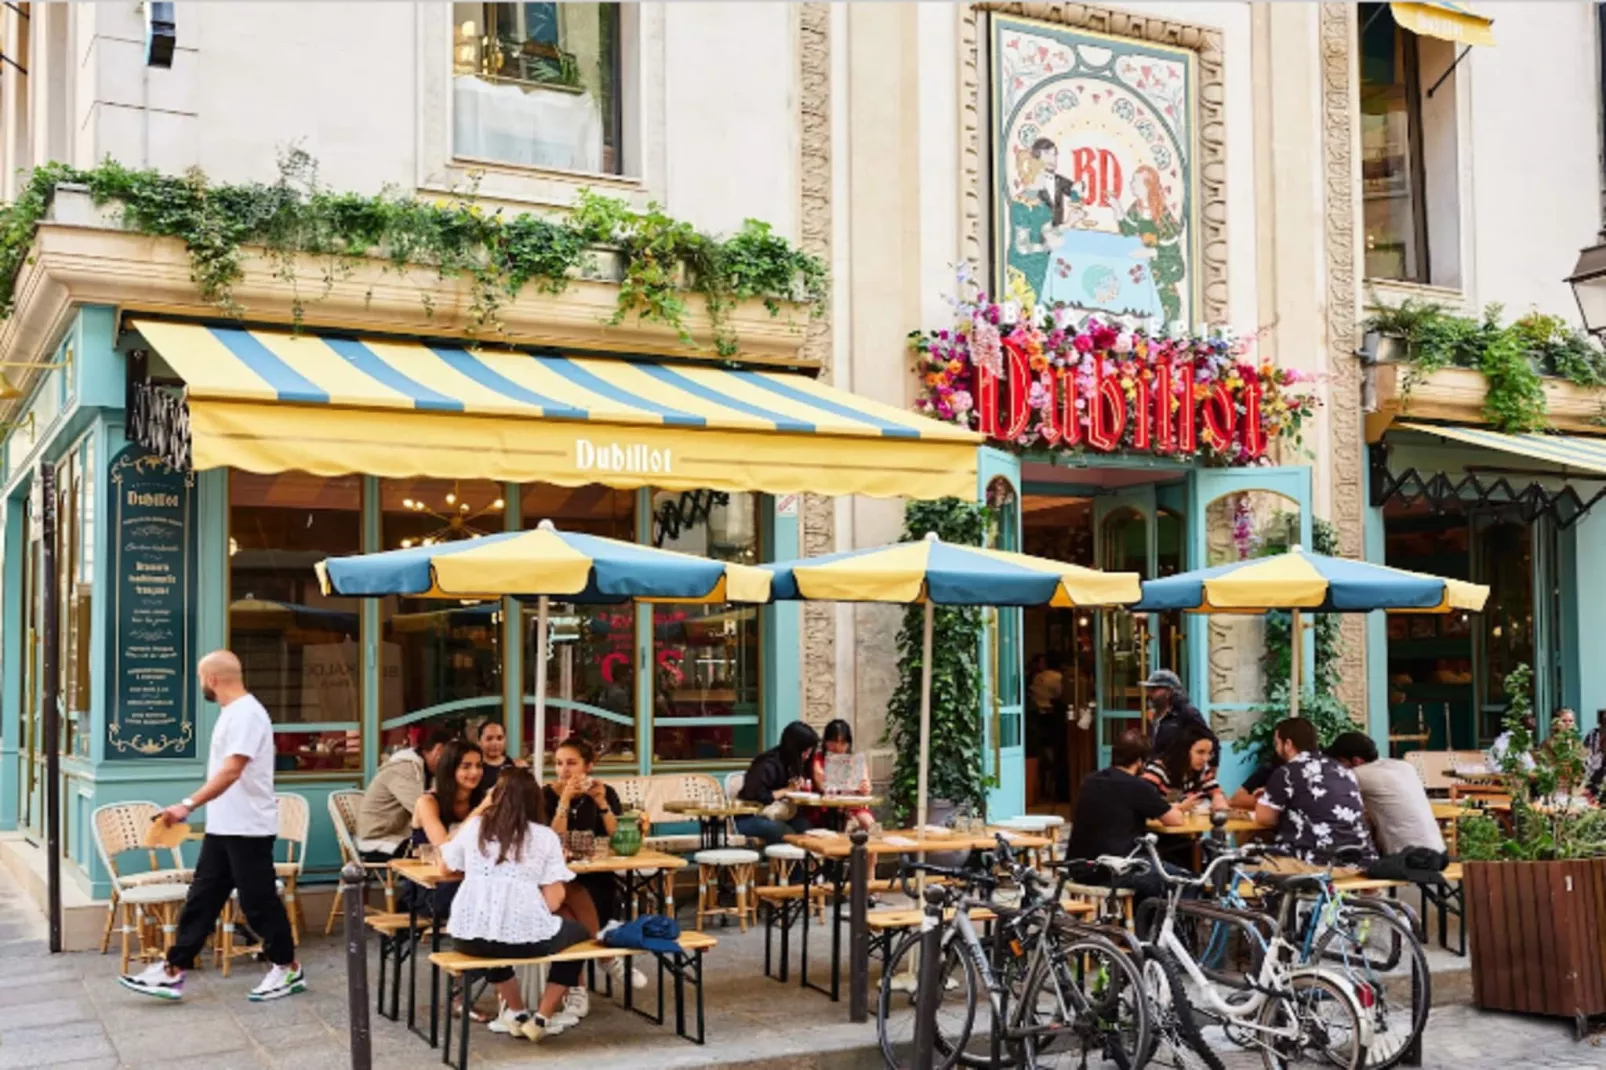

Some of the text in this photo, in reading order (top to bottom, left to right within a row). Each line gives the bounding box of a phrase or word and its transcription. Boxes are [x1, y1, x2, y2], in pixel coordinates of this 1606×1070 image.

[1072, 146, 1123, 207] BD
[970, 337, 1268, 458] Dubillot
[575, 438, 672, 473] Dubillot
